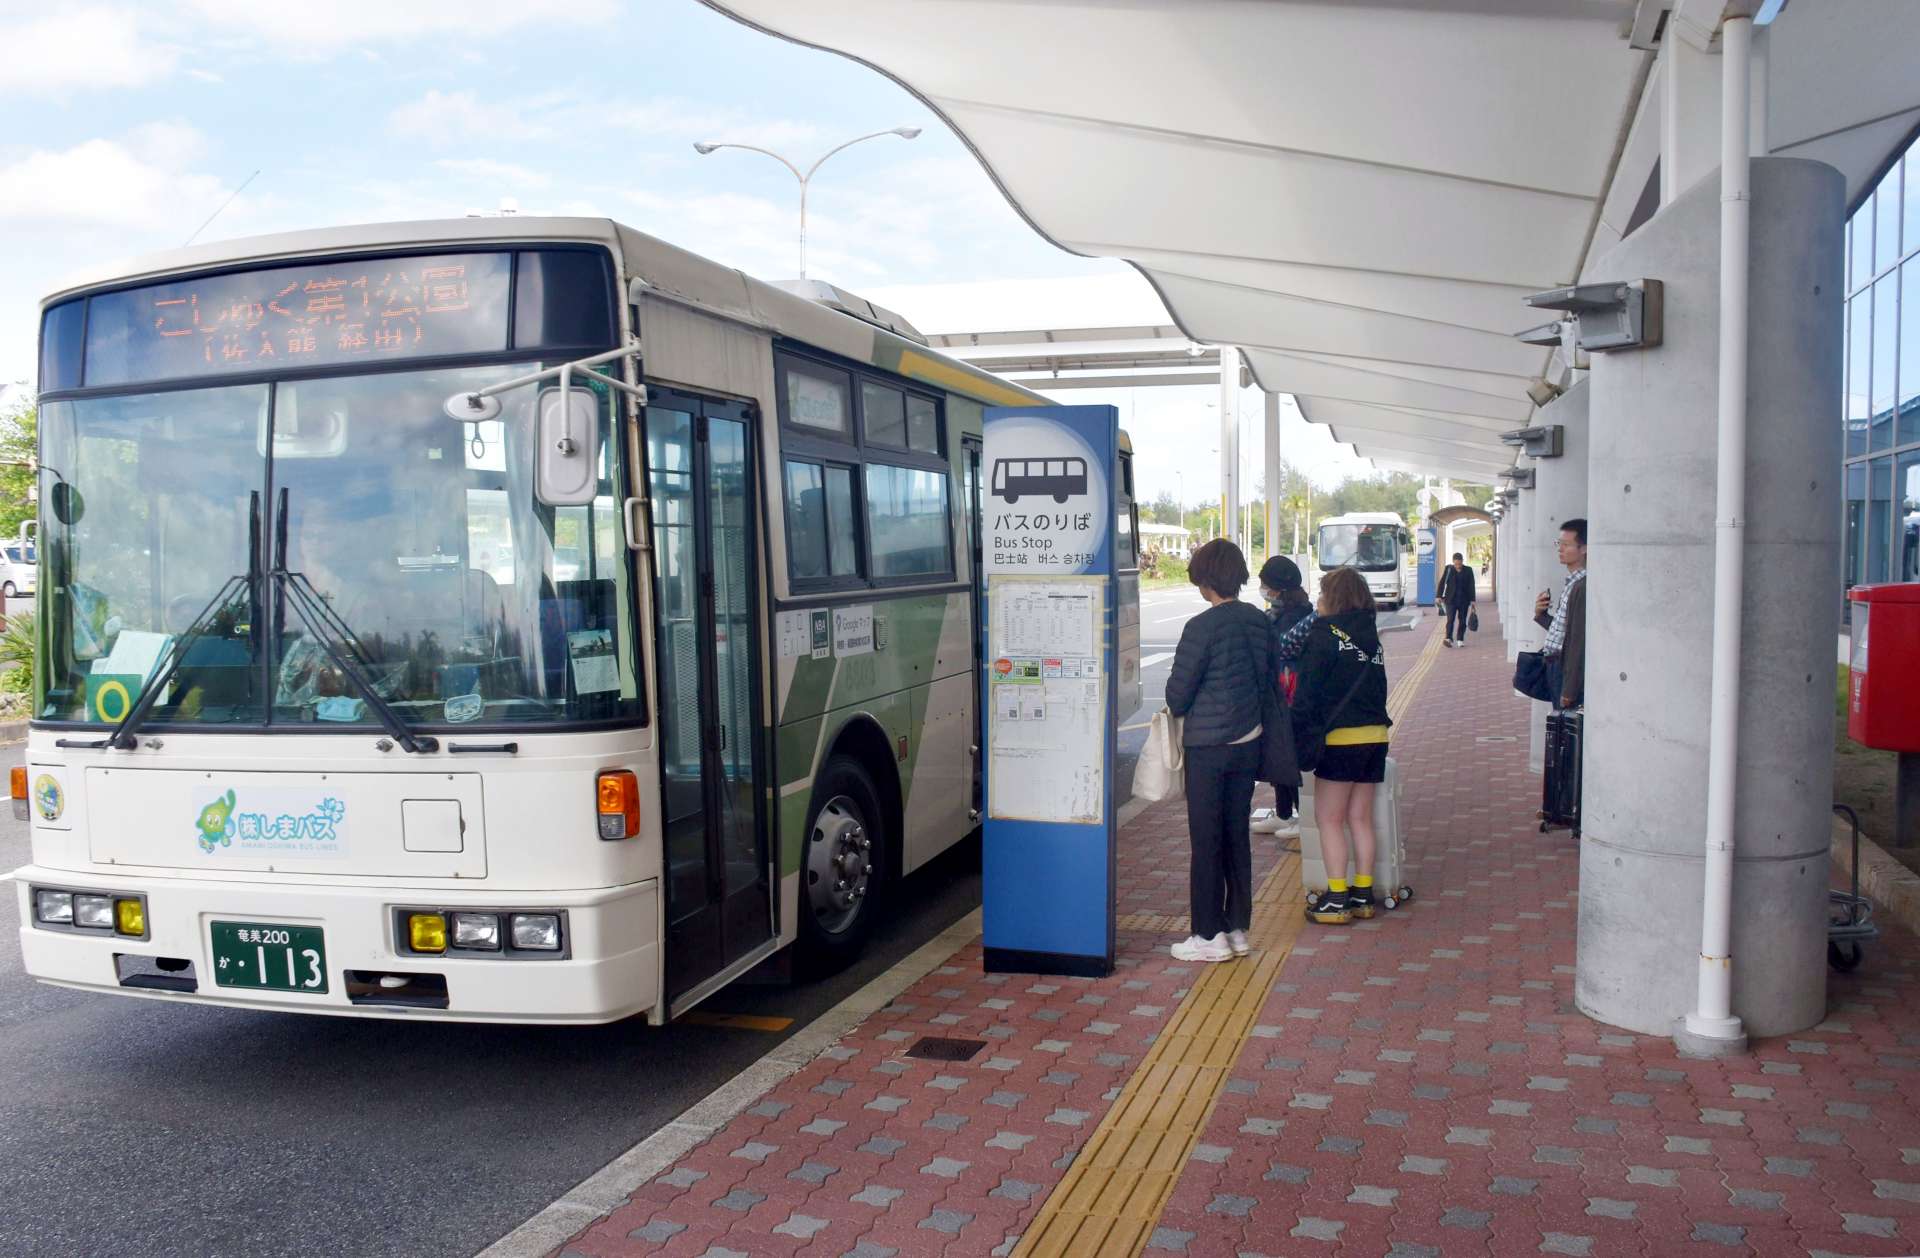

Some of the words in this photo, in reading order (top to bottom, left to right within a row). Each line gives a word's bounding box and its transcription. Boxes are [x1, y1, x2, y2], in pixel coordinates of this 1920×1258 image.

[994, 512, 1092, 531] バスのりば
[994, 537, 1018, 549] Bus
[1021, 536, 1053, 551] Stop
[994, 553, 1028, 565] 巴士站
[1038, 553, 1059, 565] 버스
[1063, 553, 1096, 565] 승차장
[237, 929, 290, 944] 奄美200
[218, 956, 231, 969] か
